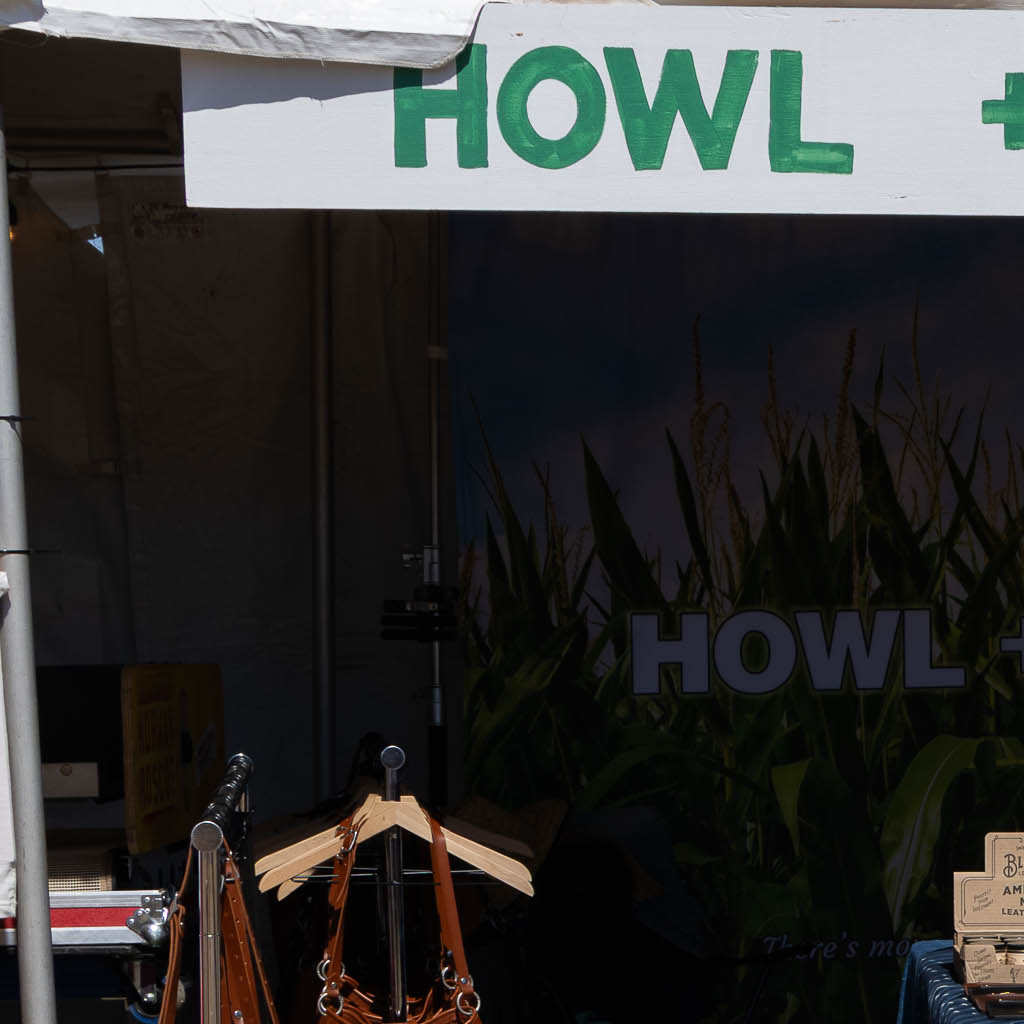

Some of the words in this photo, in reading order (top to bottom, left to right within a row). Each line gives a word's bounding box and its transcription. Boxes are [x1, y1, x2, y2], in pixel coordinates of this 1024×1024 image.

[393, 42, 854, 174] HOWL
[631, 608, 967, 694] HOWL
[762, 930, 860, 960] Thre's
